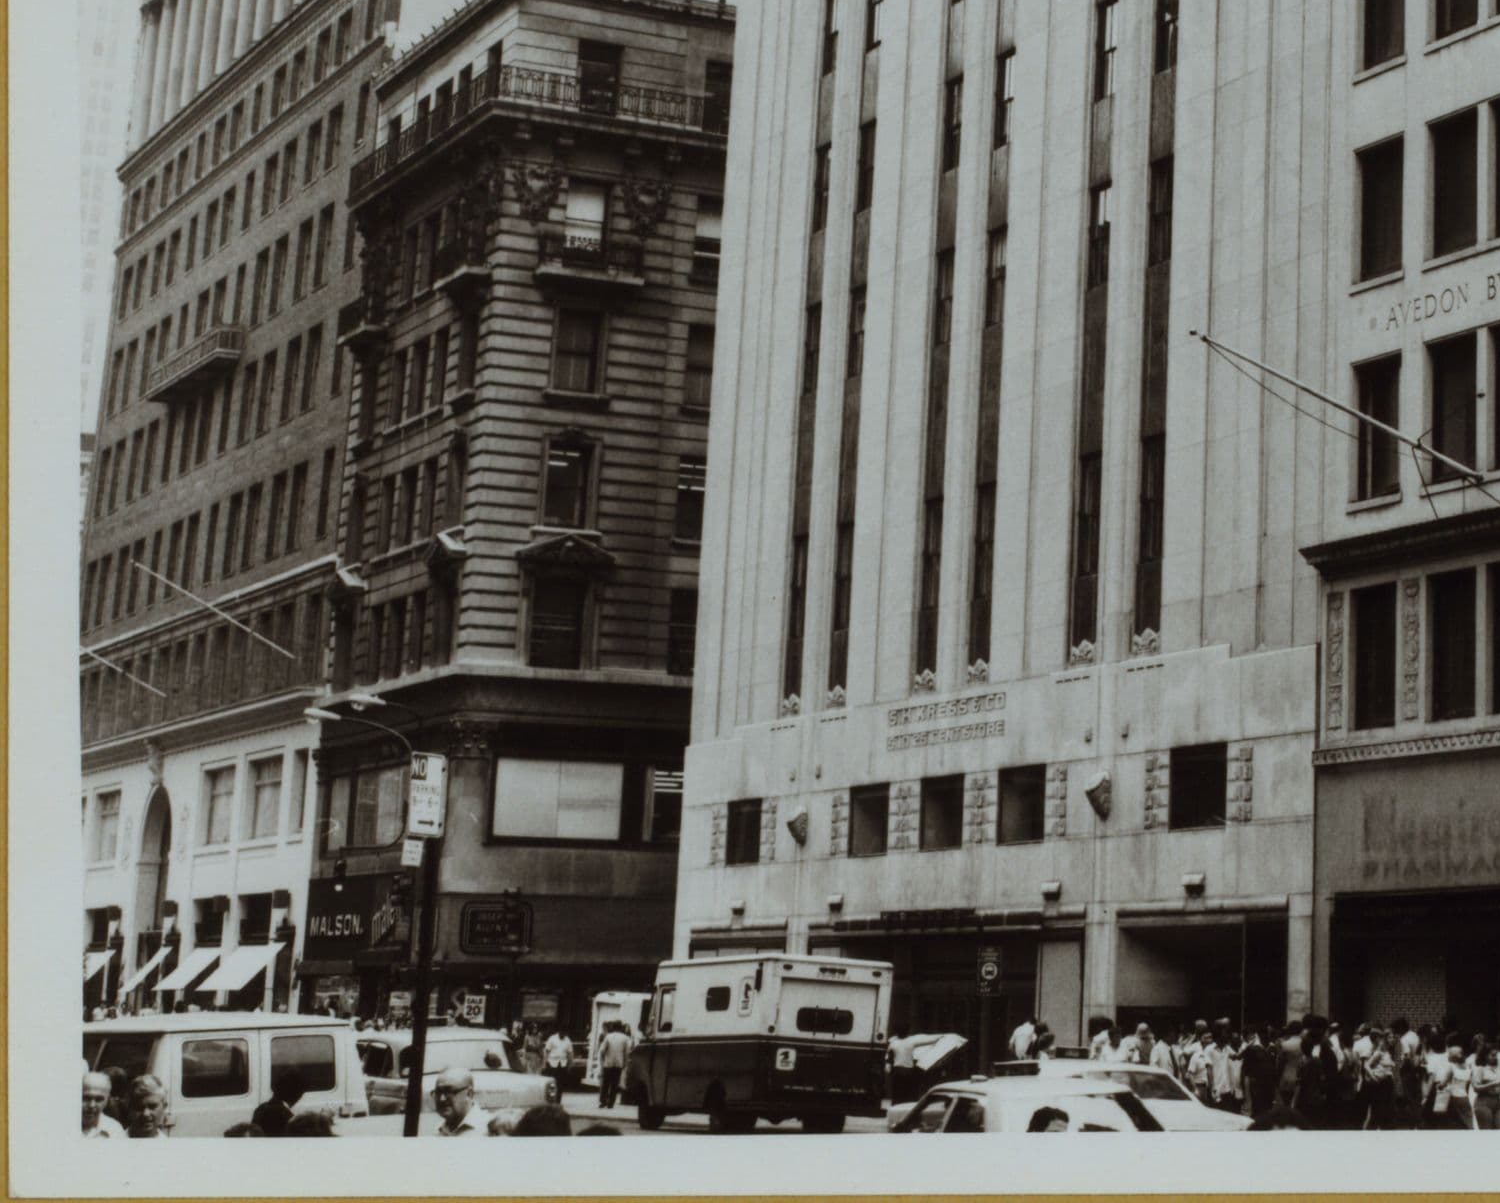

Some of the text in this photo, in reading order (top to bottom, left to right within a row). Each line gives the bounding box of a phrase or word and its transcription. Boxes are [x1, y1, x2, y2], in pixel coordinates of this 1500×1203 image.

[1385, 282, 1470, 331] AVEDON
[916, 698, 968, 722] KRESS
[411, 757, 428, 777] NO
[465, 1004, 481, 1016] 20
[466, 997, 483, 1005] SALE
